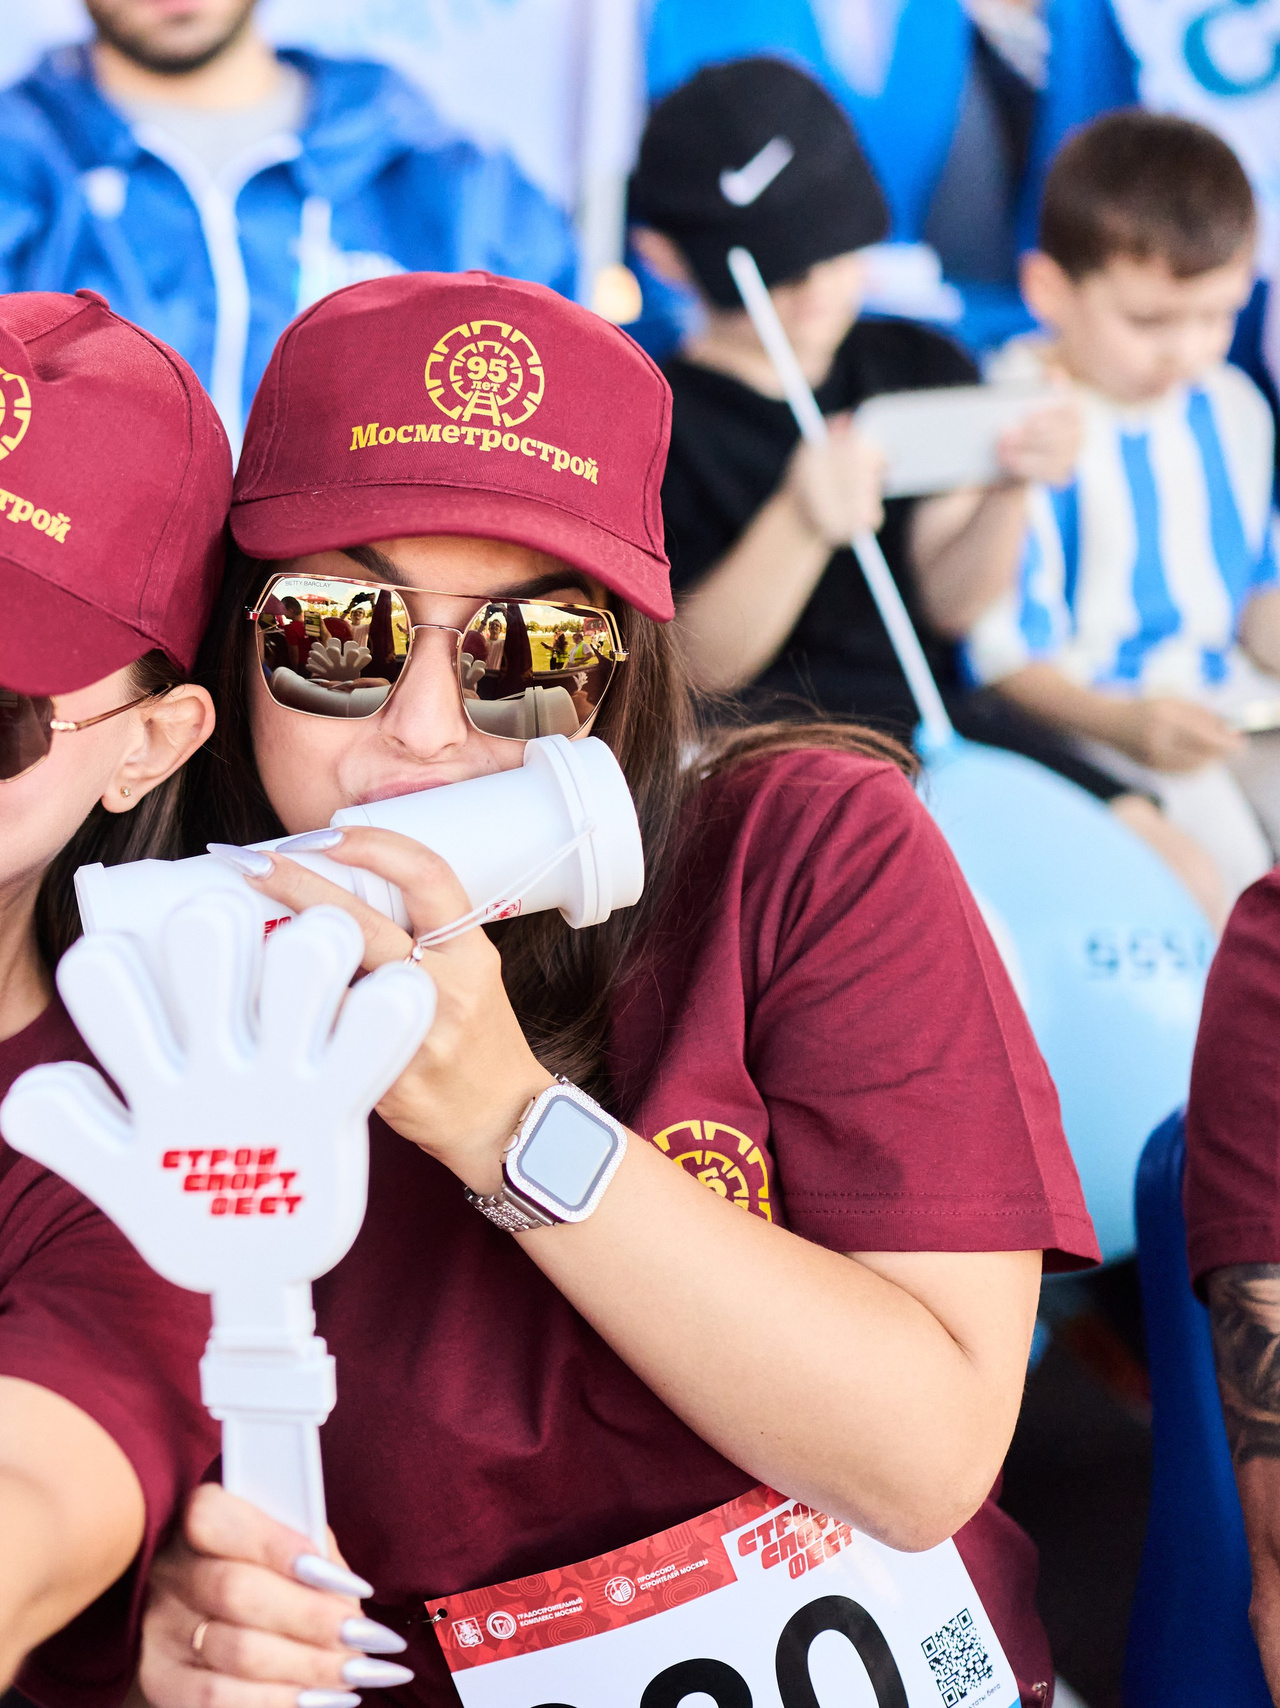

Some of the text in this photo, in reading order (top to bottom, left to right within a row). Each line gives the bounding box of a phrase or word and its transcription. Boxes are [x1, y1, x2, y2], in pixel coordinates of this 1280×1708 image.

[466, 356, 509, 383] 95
[471, 379, 500, 393] лет
[349, 422, 599, 485] Мосметрострой
[304, 580, 332, 588] BARCLAY
[183, 1171, 297, 1192] СПОРТ
[697, 1166, 728, 1198] 5
[637, 1563, 676, 1583] ПРОФСОЮЗ
[639, 1558, 709, 1590] СТРОИТЕЛЕЙ МОСКВЫ
[519, 1605, 583, 1627] КОМПЛЕКС МОСКВЫ
